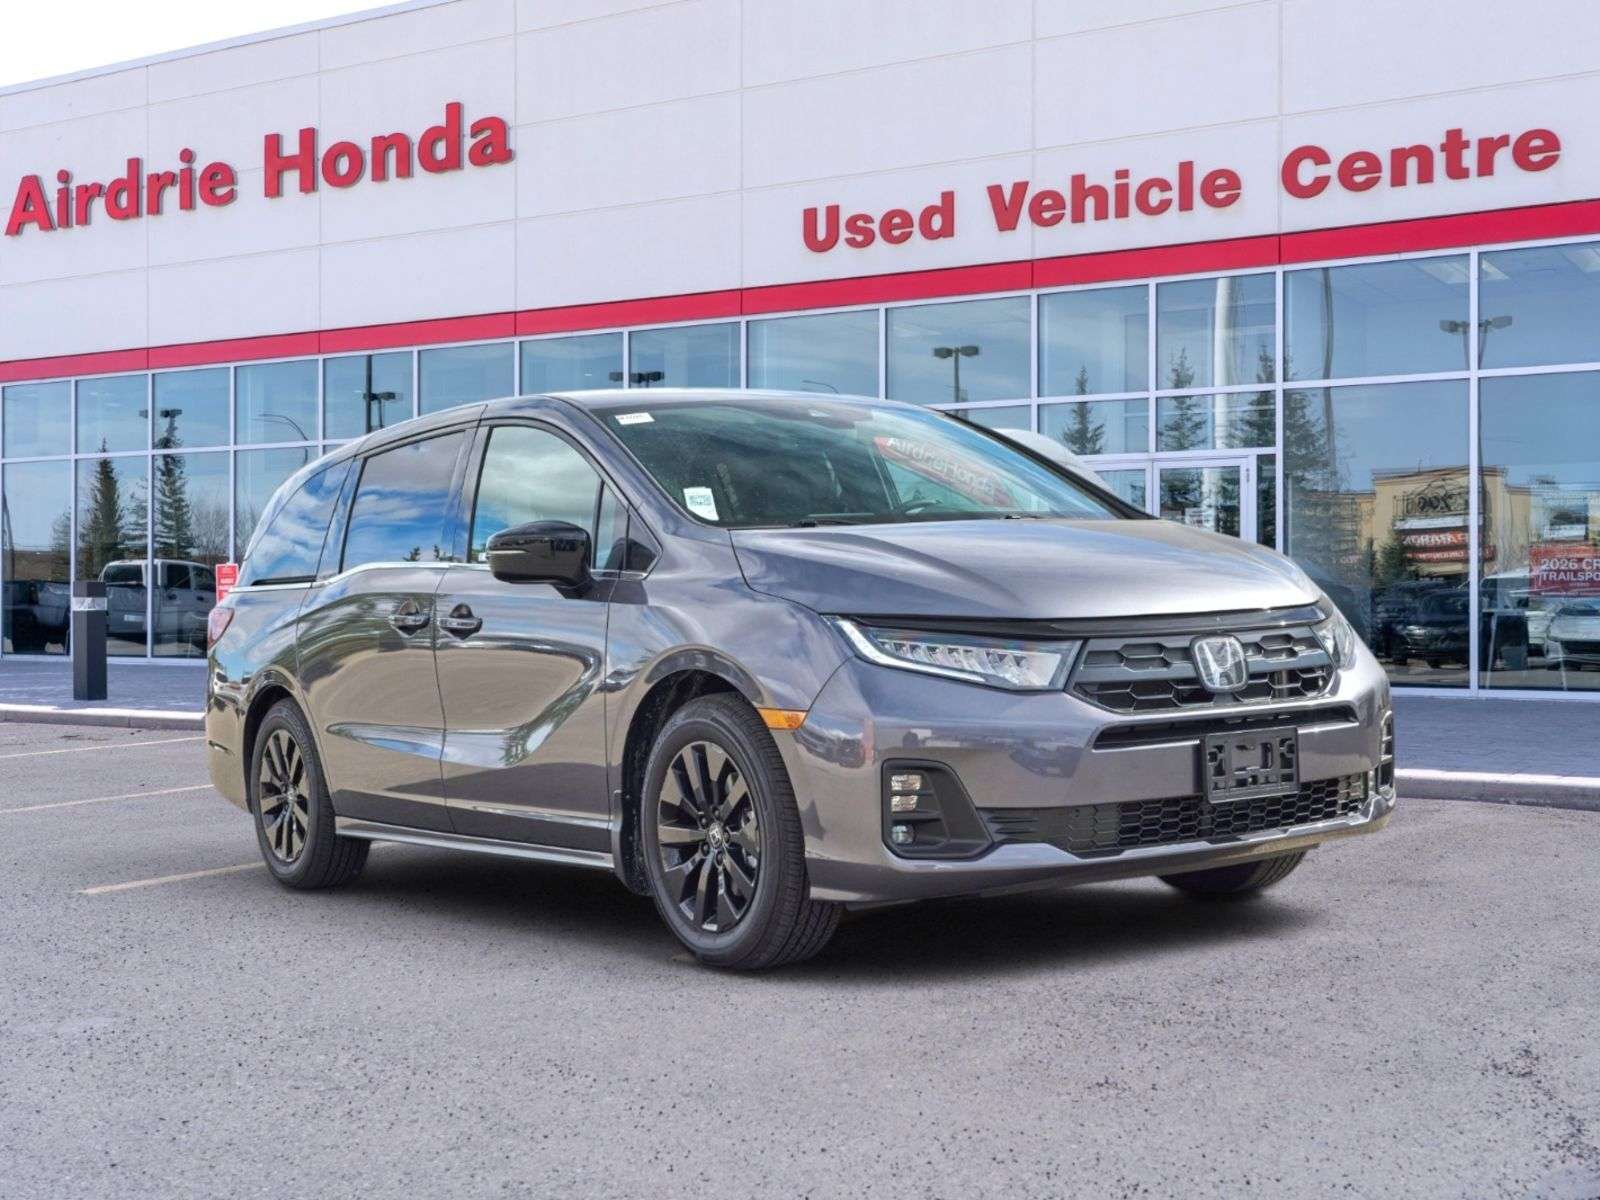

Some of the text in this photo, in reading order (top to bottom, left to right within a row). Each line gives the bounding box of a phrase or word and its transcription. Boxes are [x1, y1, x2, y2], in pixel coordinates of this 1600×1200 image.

[6, 102, 514, 235] Airdrie Honda
[803, 128, 1562, 253] Used Vehicle Centre
[1541, 558, 1578, 570] 2026
